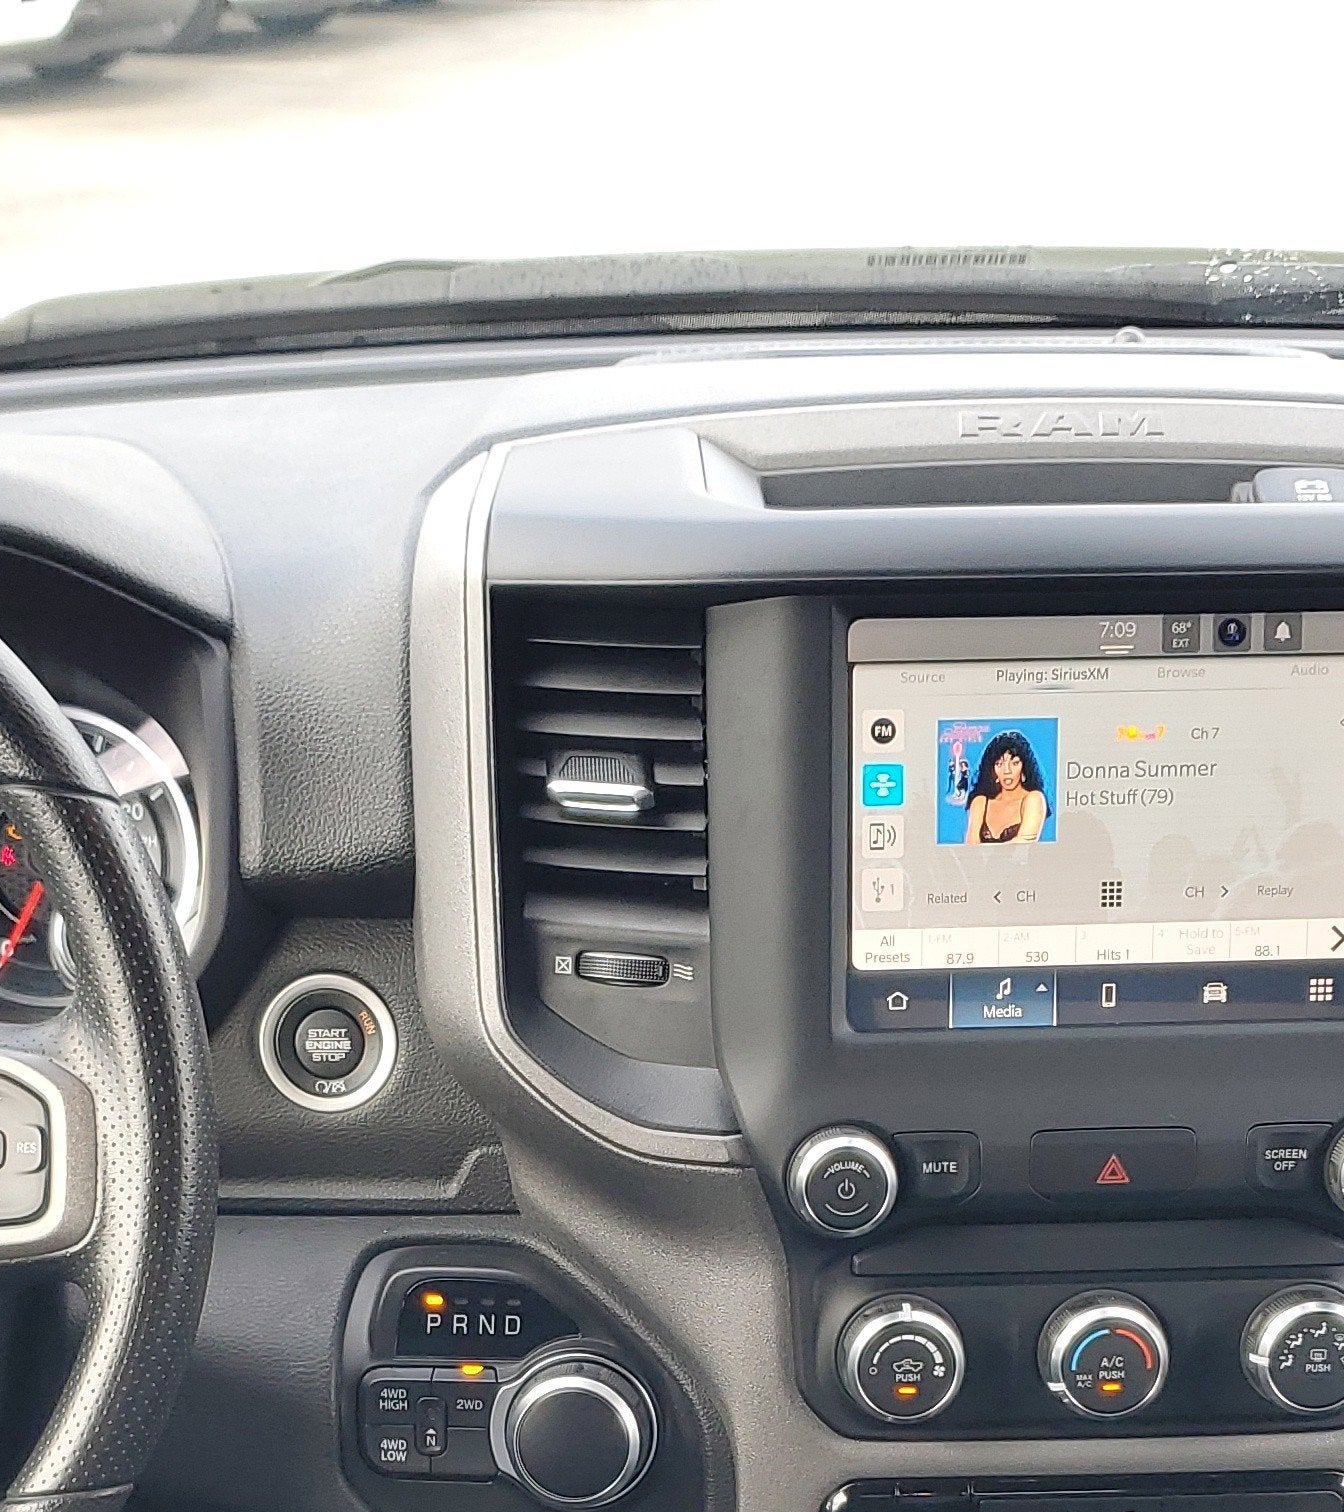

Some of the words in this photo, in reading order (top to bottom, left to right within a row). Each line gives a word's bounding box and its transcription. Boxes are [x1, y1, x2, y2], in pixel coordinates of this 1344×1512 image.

[957, 410, 1164, 439] RAM
[1099, 621, 1137, 638] 7:09
[1172, 638, 1190, 648] EXT
[996, 669, 1048, 684] Playing:
[1051, 667, 1109, 681] SiriusXM
[1157, 666, 1206, 679] Browse
[1291, 664, 1329, 676] Audio
[900, 671, 946, 684] Source
[874, 724, 893, 738] FM
[1191, 727, 1208, 740] Ch
[1212, 727, 1220, 739] 7
[1066, 761, 1130, 780] Donna
[1134, 760, 1218, 779] Summer
[1066, 790, 1096, 806] Hot
[1099, 788, 1139, 806] Stuff
[1141, 788, 1174, 807] (79)
[1016, 890, 1036, 903] CH
[1185, 886, 1204, 898] CH
[1257, 885, 1293, 897] Replay
[927, 892, 967, 905] Related
[1179, 928, 1208, 939] Hold
[1212, 928, 1224, 939] to
[880, 936, 895, 947] All
[1097, 949, 1121, 961] Hits
[1186, 944, 1215, 955] Save
[1254, 946, 1281, 957] 88.1
[865, 952, 911, 963] Presets
[946, 952, 974, 965] 87.9
[1025, 951, 1049, 963] 530
[983, 1005, 1023, 1018] Media
[359, 1010, 376, 1036] RUN
[308, 1028, 348, 1038] START
[306, 1041, 352, 1050] ENGINE
[312, 1052, 346, 1062] STOP
[16, 1142, 37, 1154] RES
[1264, 1148, 1307, 1159] SCREEN
[827, 1160, 865, 1174] VOLUME
[922, 1161, 958, 1174] MUTE
[1274, 1160, 1296, 1171] OFF
[1100, 1356, 1124, 1368] A/C
[1305, 1363, 1332, 1373] PUSH
[895, 1373, 921, 1383] PUSH
[1098, 1370, 1125, 1380] PUSH
[380, 1388, 407, 1399] 4WD
[379, 1399, 408, 1411] HIGH
[456, 1399, 484, 1410] 2WD
[380, 1439, 407, 1450] 4WD
[425, 1435, 437, 1447] N
[380, 1451, 407, 1462] LOW
